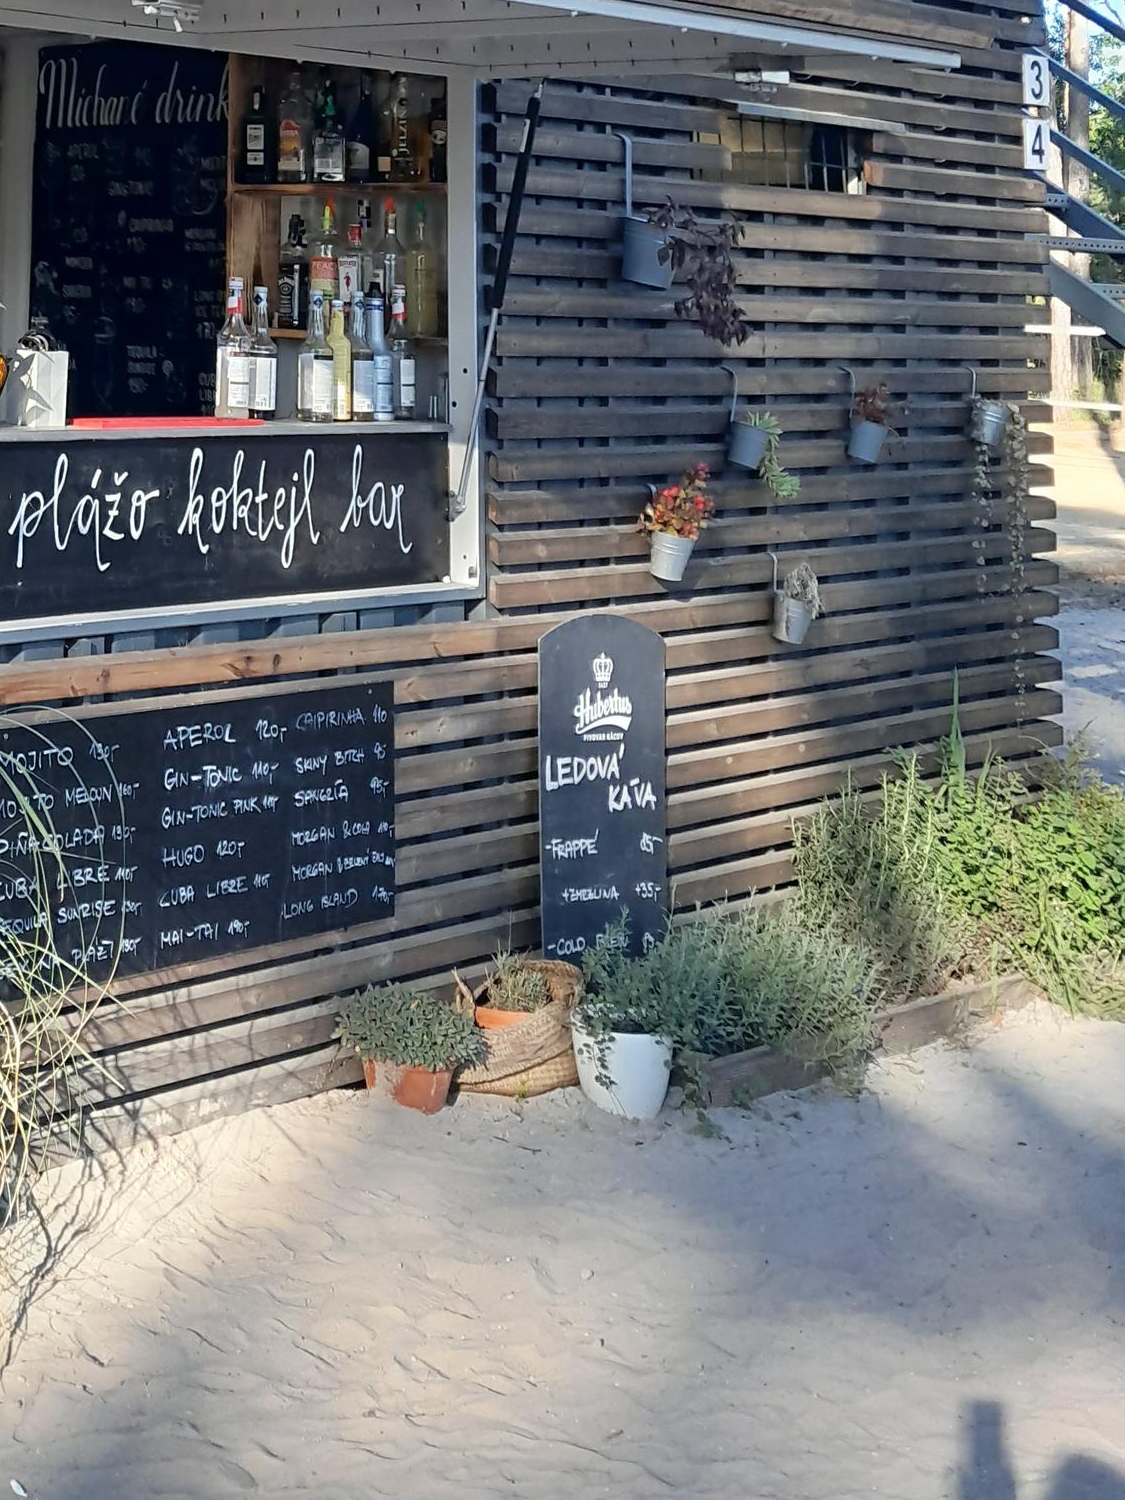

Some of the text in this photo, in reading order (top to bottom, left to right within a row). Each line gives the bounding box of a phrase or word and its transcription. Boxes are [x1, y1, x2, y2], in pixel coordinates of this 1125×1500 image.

[1030, 60, 1044, 100] 3
[1031, 124, 1046, 165] 4
[8, 452, 161, 572] plážo
[177, 446, 321, 569] koktejl
[339, 443, 414, 555] bar
[573, 686, 633, 729] Hubertus
[163, 722, 237, 751] APEROL
[164, 764, 243, 791] GIN-TONIC
[545, 744, 625, 791] LEDOVÁ
[608, 777, 657, 813] KÁVA
[161, 797, 262, 829] GIN-TONIC PINK
[291, 826, 335, 846] MORGAN
[162, 844, 205, 868] HUGO
[291, 862, 333, 882] MORGAN
[159, 876, 249, 908] CUBA LIBRE
[283, 900, 315, 920] LONG
[321, 888, 359, 910] ISLAND
[57, 900, 117, 924] SUNRISE
[160, 922, 219, 949] MAI-TAI
